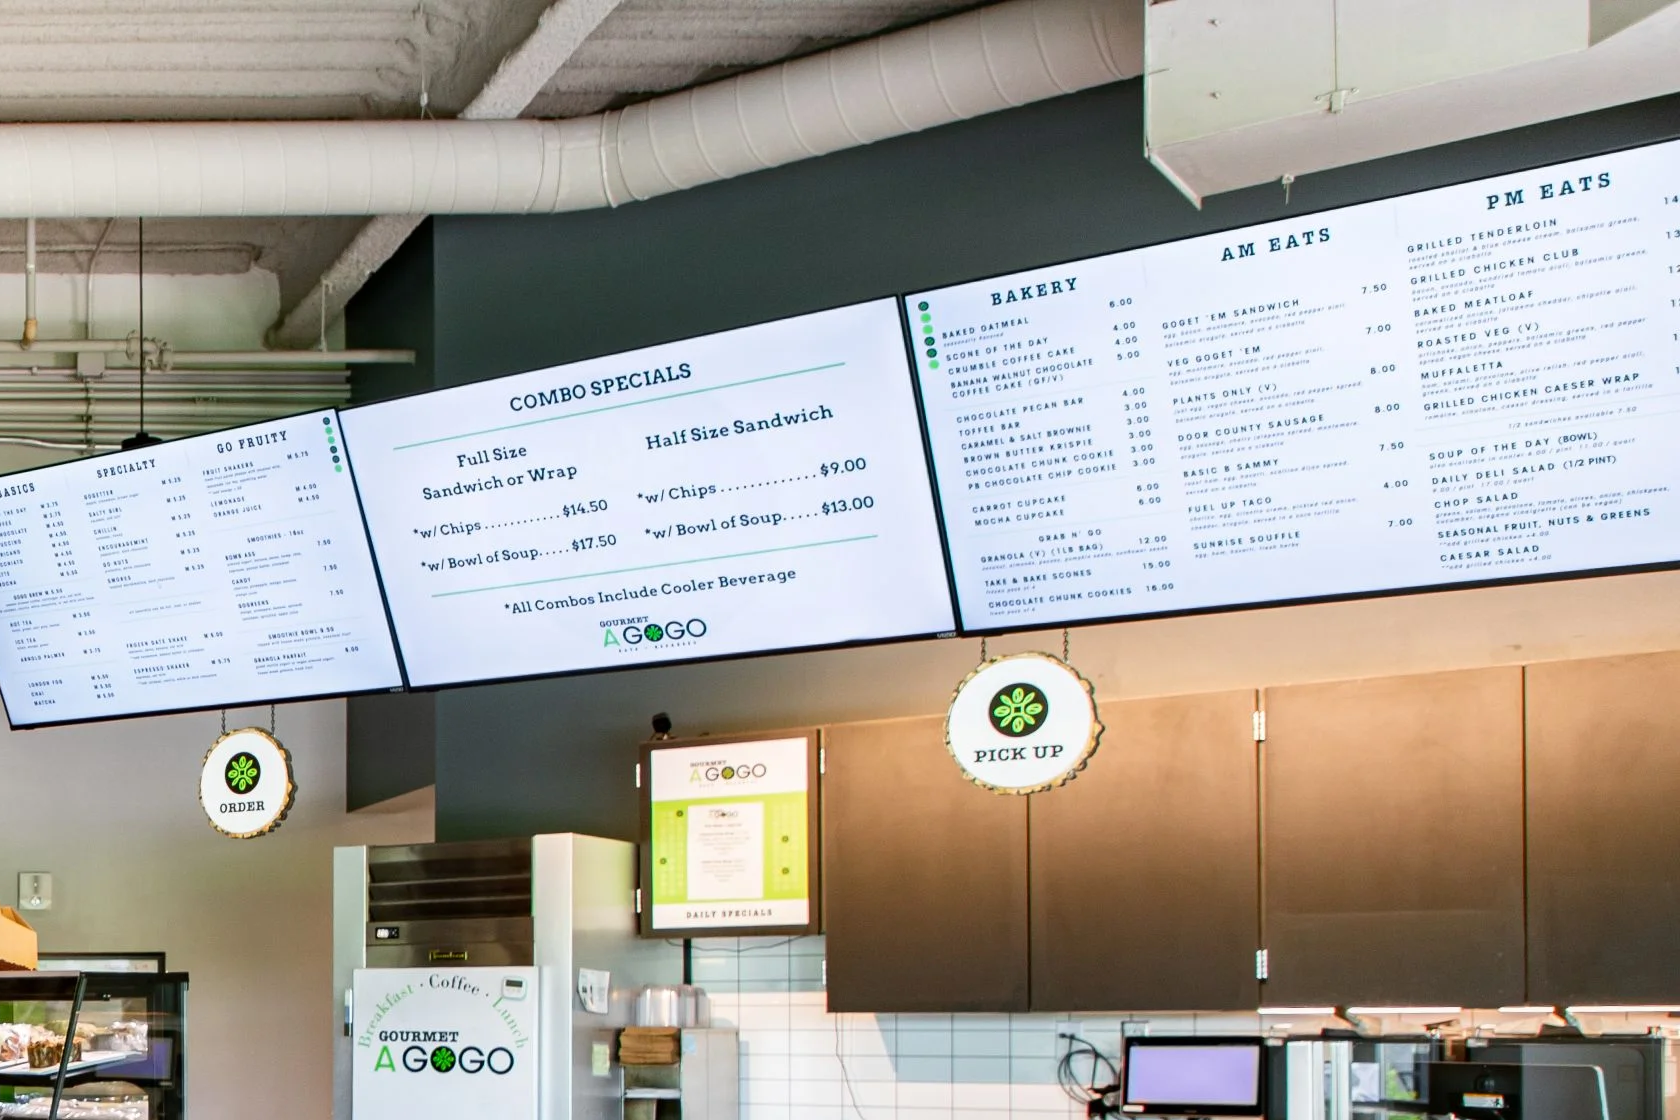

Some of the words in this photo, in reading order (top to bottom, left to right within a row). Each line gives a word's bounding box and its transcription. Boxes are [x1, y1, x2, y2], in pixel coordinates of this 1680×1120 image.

[1486, 188, 1525, 210] PM
[1539, 171, 1611, 200] EATS
[1220, 242, 1256, 262] AM
[1268, 227, 1330, 253] EATS
[1407, 236, 1463, 254] GRILLED
[1471, 218, 1557, 241] TENDERLOIN
[1410, 268, 1466, 285] GRILLED
[1473, 256, 1535, 274] CHICKEN
[1543, 248, 1579, 262] CLUB
[990, 277, 1077, 306] BAKERY
[1413, 303, 1456, 318] BAKED
[1464, 290, 1533, 309] MEATLOAF
[941, 327, 975, 340] BAKED
[980, 317, 1029, 332] OATMEAL
[1108, 297, 1133, 309] 6.00
[945, 349, 980, 362] SCONE
[985, 345, 997, 355] OF
[1003, 341, 1022, 351] THE
[1028, 337, 1048, 347] DAY
[1112, 321, 1136, 331] 4.00
[947, 360, 996, 376] CRUMBLE
[1002, 352, 1041, 366] COFFEE
[1047, 346, 1074, 358] CAKE
[1114, 335, 1138, 346] 4.00
[1420, 361, 1503, 380] MUFFALETTA
[509, 384, 587, 412] COMBO
[590, 362, 692, 397] SPECIALS
[1423, 397, 1475, 411] GRILLED
[1481, 387, 1537, 403] CHICKEN
[1544, 379, 1595, 394] CAESER
[1601, 372, 1640, 385] WRAP
[956, 407, 1017, 424] CHOCOLATE
[1022, 401, 1057, 413] PECAN
[1063, 397, 1083, 407] BAR
[1122, 387, 1145, 397] 4.00
[958, 425, 995, 437] TOFFEE
[1000, 421, 1020, 431] BAR
[1124, 401, 1147, 412] 3.00
[645, 429, 687, 450] Half
[690, 425, 729, 442] Size
[732, 404, 834, 435] Sandwich
[1177, 431, 1209, 442] DOOR
[1215, 423, 1261, 437] COUNTY
[1268, 413, 1323, 429] SAUSAGE
[1374, 402, 1400, 414] 8.00
[216, 441, 233, 454] GO
[238, 430, 287, 450] FRUITY
[1429, 449, 1463, 461] SOUP
[1470, 446, 1485, 455] OF
[1494, 441, 1517, 452] THE
[1524, 437, 1550, 448] DAY
[1557, 431, 1598, 445] (BOWL)
[96, 458, 156, 479] SPECIALTY
[202, 467, 221, 476] FRUIT
[223, 461, 254, 472] SHAKERS
[456, 449, 490, 468] Full
[492, 446, 527, 461] Size
[820, 457, 867, 478] $9.00
[1183, 467, 1217, 478] BASIC
[1223, 465, 1230, 473] B
[1236, 458, 1278, 471] SAMMY
[1379, 441, 1405, 452] 7.50
[422, 475, 504, 501] Sandwich
[506, 475, 524, 486] or
[526, 466, 578, 482] Wrap
[1187, 504, 1214, 513] FUEL
[1221, 501, 1236, 510] UP
[1242, 496, 1272, 507] TACO
[1383, 479, 1409, 489] 4.00
[210, 496, 245, 507] LEMONADE
[213, 508, 239, 518] ORANGE
[242, 504, 262, 513] JUICE
[562, 499, 608, 518] $14.50
[1434, 497, 1469, 509] CHOP
[1476, 492, 1518, 504] SALAD
[675, 518, 718, 536] Bowl
[720, 515, 737, 530] of
[821, 495, 875, 516] $13.00
[1193, 537, 1243, 550] SUNRISE
[1249, 531, 1300, 544] SOUFFLE
[1388, 517, 1413, 528] 7.00
[447, 553, 483, 569] Bowl
[485, 550, 500, 564] of
[571, 533, 617, 552] $17.50
[1440, 550, 1490, 562] CAESAR
[1497, 544, 1540, 556] SALAD
[534, 595, 596, 611] Combos
[597, 585, 658, 604] Include
[660, 579, 714, 595] Cooler
[717, 570, 796, 588] Beverage
[268, 630, 298, 640] SMOOTHIE
[599, 615, 649, 628] GOURMET
[126, 641, 149, 649] FROZEN
[150, 638, 166, 646] DATE
[167, 635, 187, 644] SHAKE
[603, 629, 620, 648] A
[973, 747, 1027, 763] PICK
[1032, 744, 1064, 759] UP
[219, 800, 265, 813] ORDER
[687, 911, 717, 919] DAILY
[722, 908, 773, 917] SPECIALS
[357, 983, 415, 1049] Breakfast
[429, 973, 480, 996] Coffee
[492, 997, 529, 1049] Lunch
[379, 1030, 459, 1042] GOURMET
[374, 1045, 396, 1072] A
